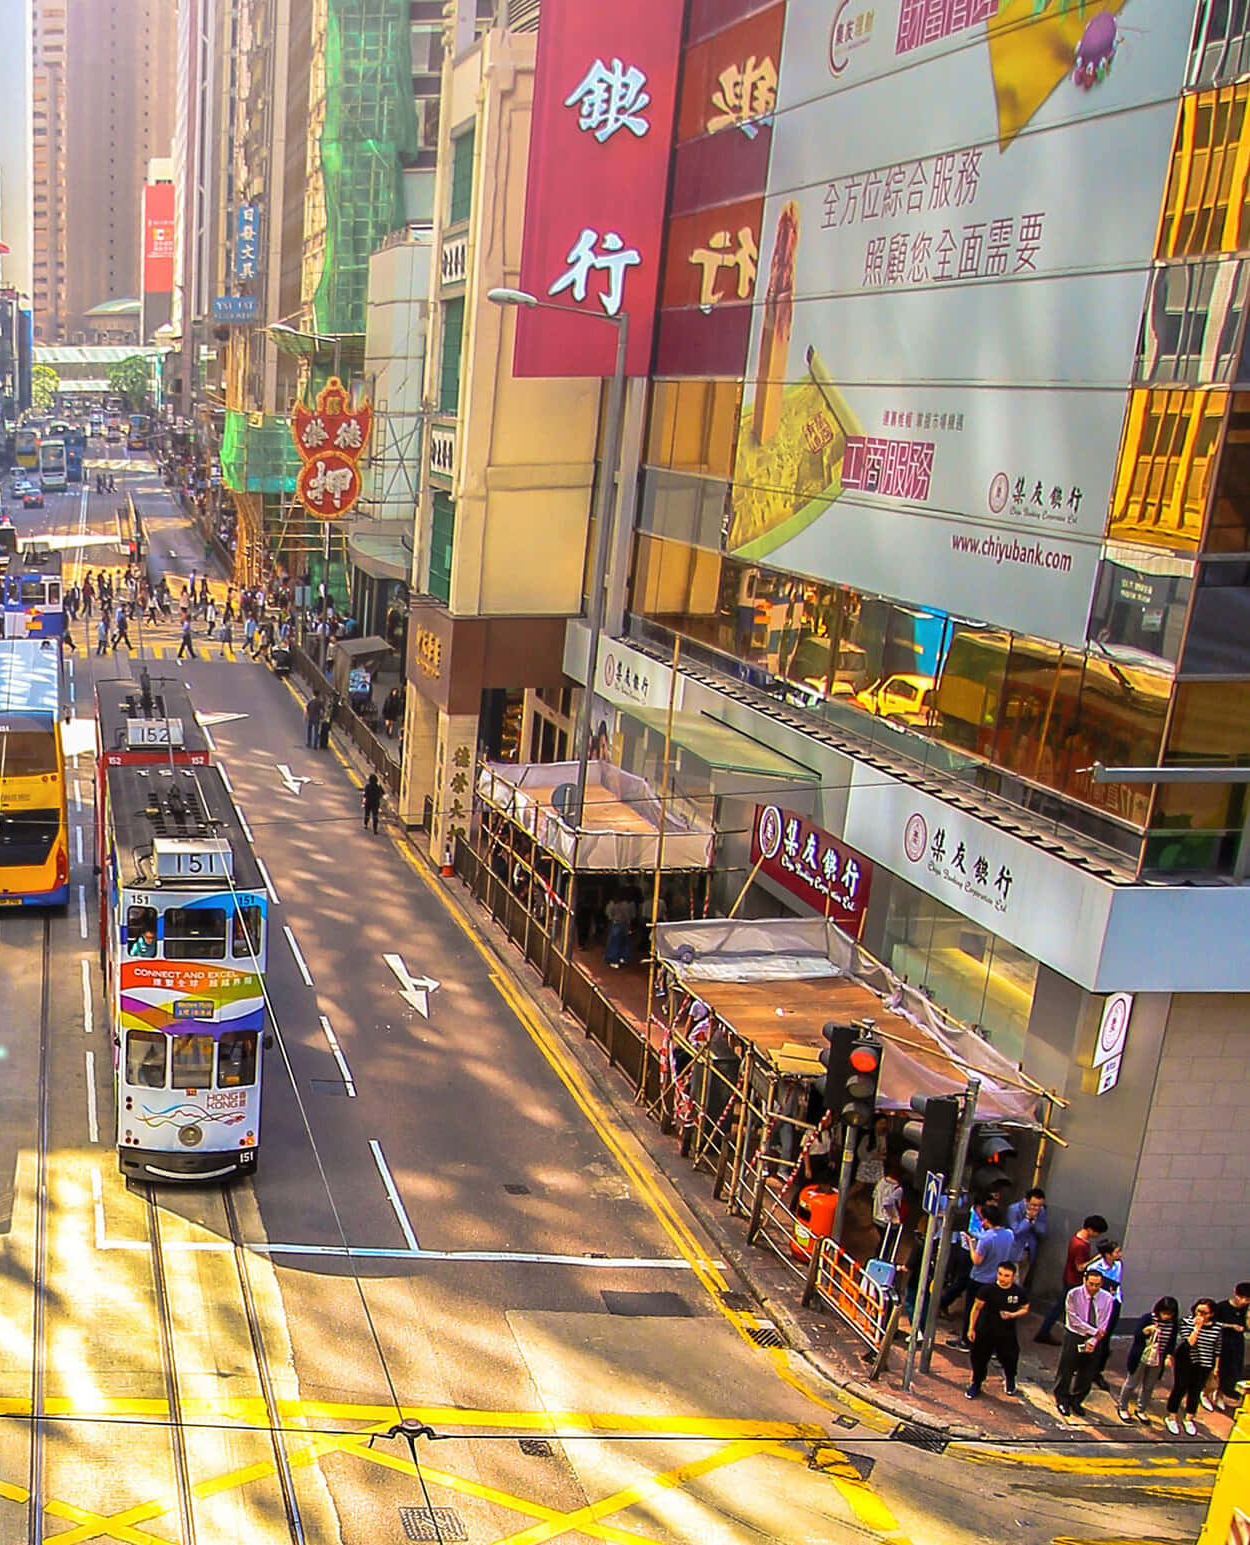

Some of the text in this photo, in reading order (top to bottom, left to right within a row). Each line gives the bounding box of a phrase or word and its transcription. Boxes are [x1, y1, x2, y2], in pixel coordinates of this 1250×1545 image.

[548, 57, 650, 316] 銀行
[820, 148, 983, 229] 全方位綜合服務
[862, 211, 1046, 287] 照顧您全面需要
[841, 439, 934, 500] 工商服務
[951, 533, 1072, 572] www.chiyubank.com
[141, 727, 171, 743] 152
[107, 756, 122, 766] 152
[191, 756, 204, 766] 152
[176, 854, 214, 874] 151
[131, 894, 149, 905] 151
[238, 894, 255, 905] 151
[134, 967, 239, 979] CONNECT AND EXCEL
[206, 1092, 239, 1102] HONG
[206, 1101, 238, 1110] KONG
[239, 1151, 254, 1164] 151
